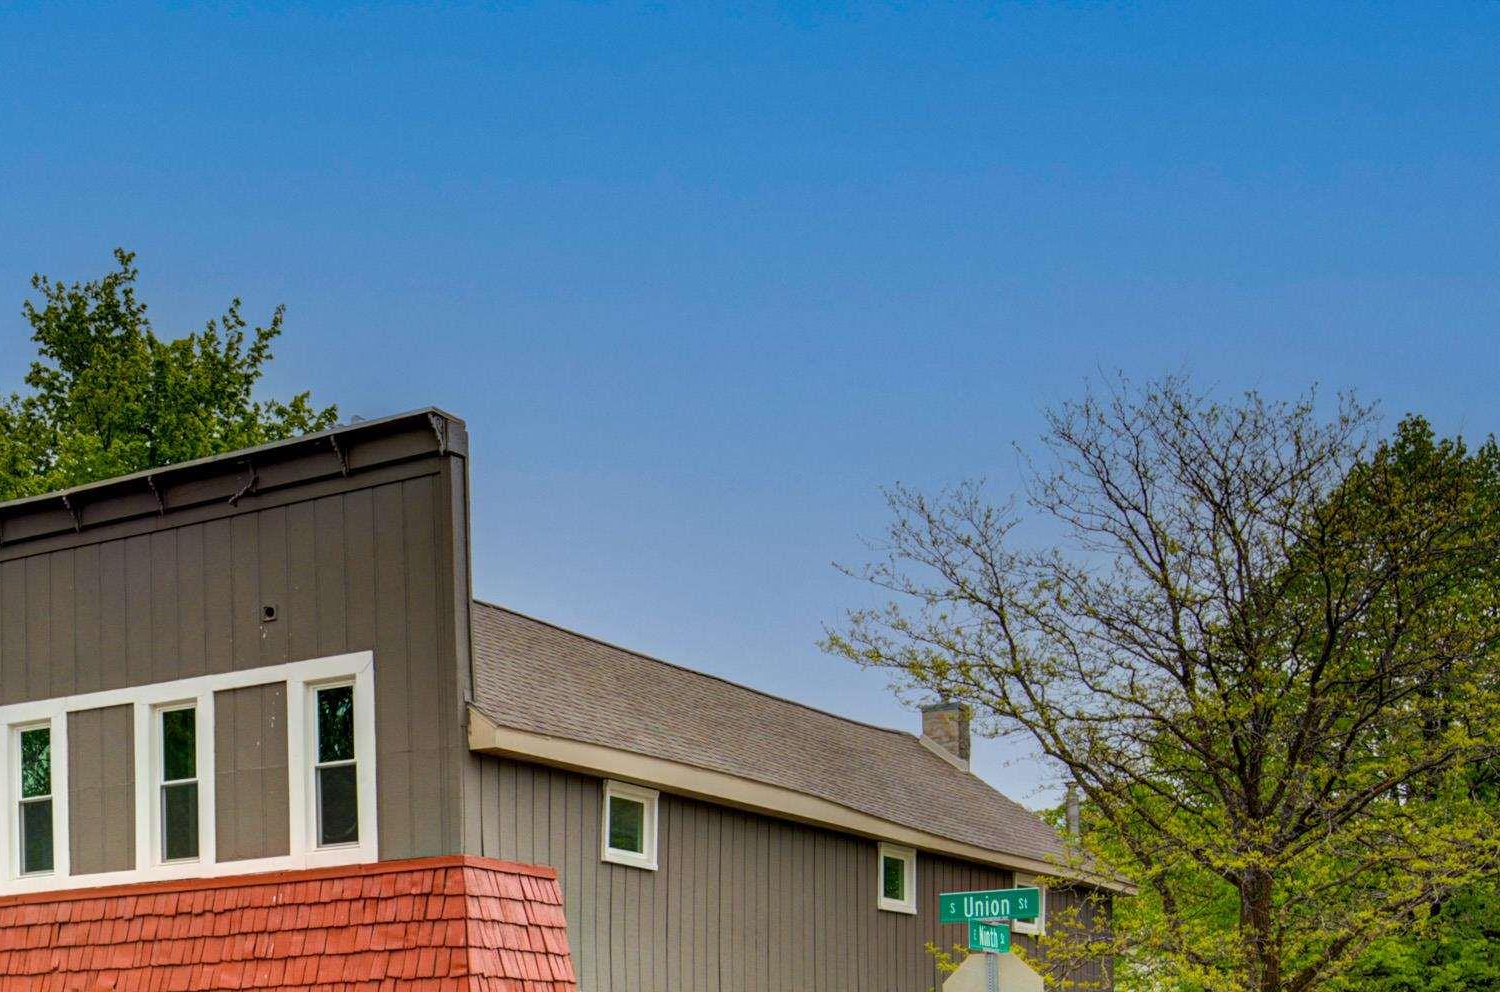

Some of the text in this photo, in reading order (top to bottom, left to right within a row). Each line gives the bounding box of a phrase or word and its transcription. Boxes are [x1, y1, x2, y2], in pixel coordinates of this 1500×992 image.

[950, 896, 1028, 917] S Union St
